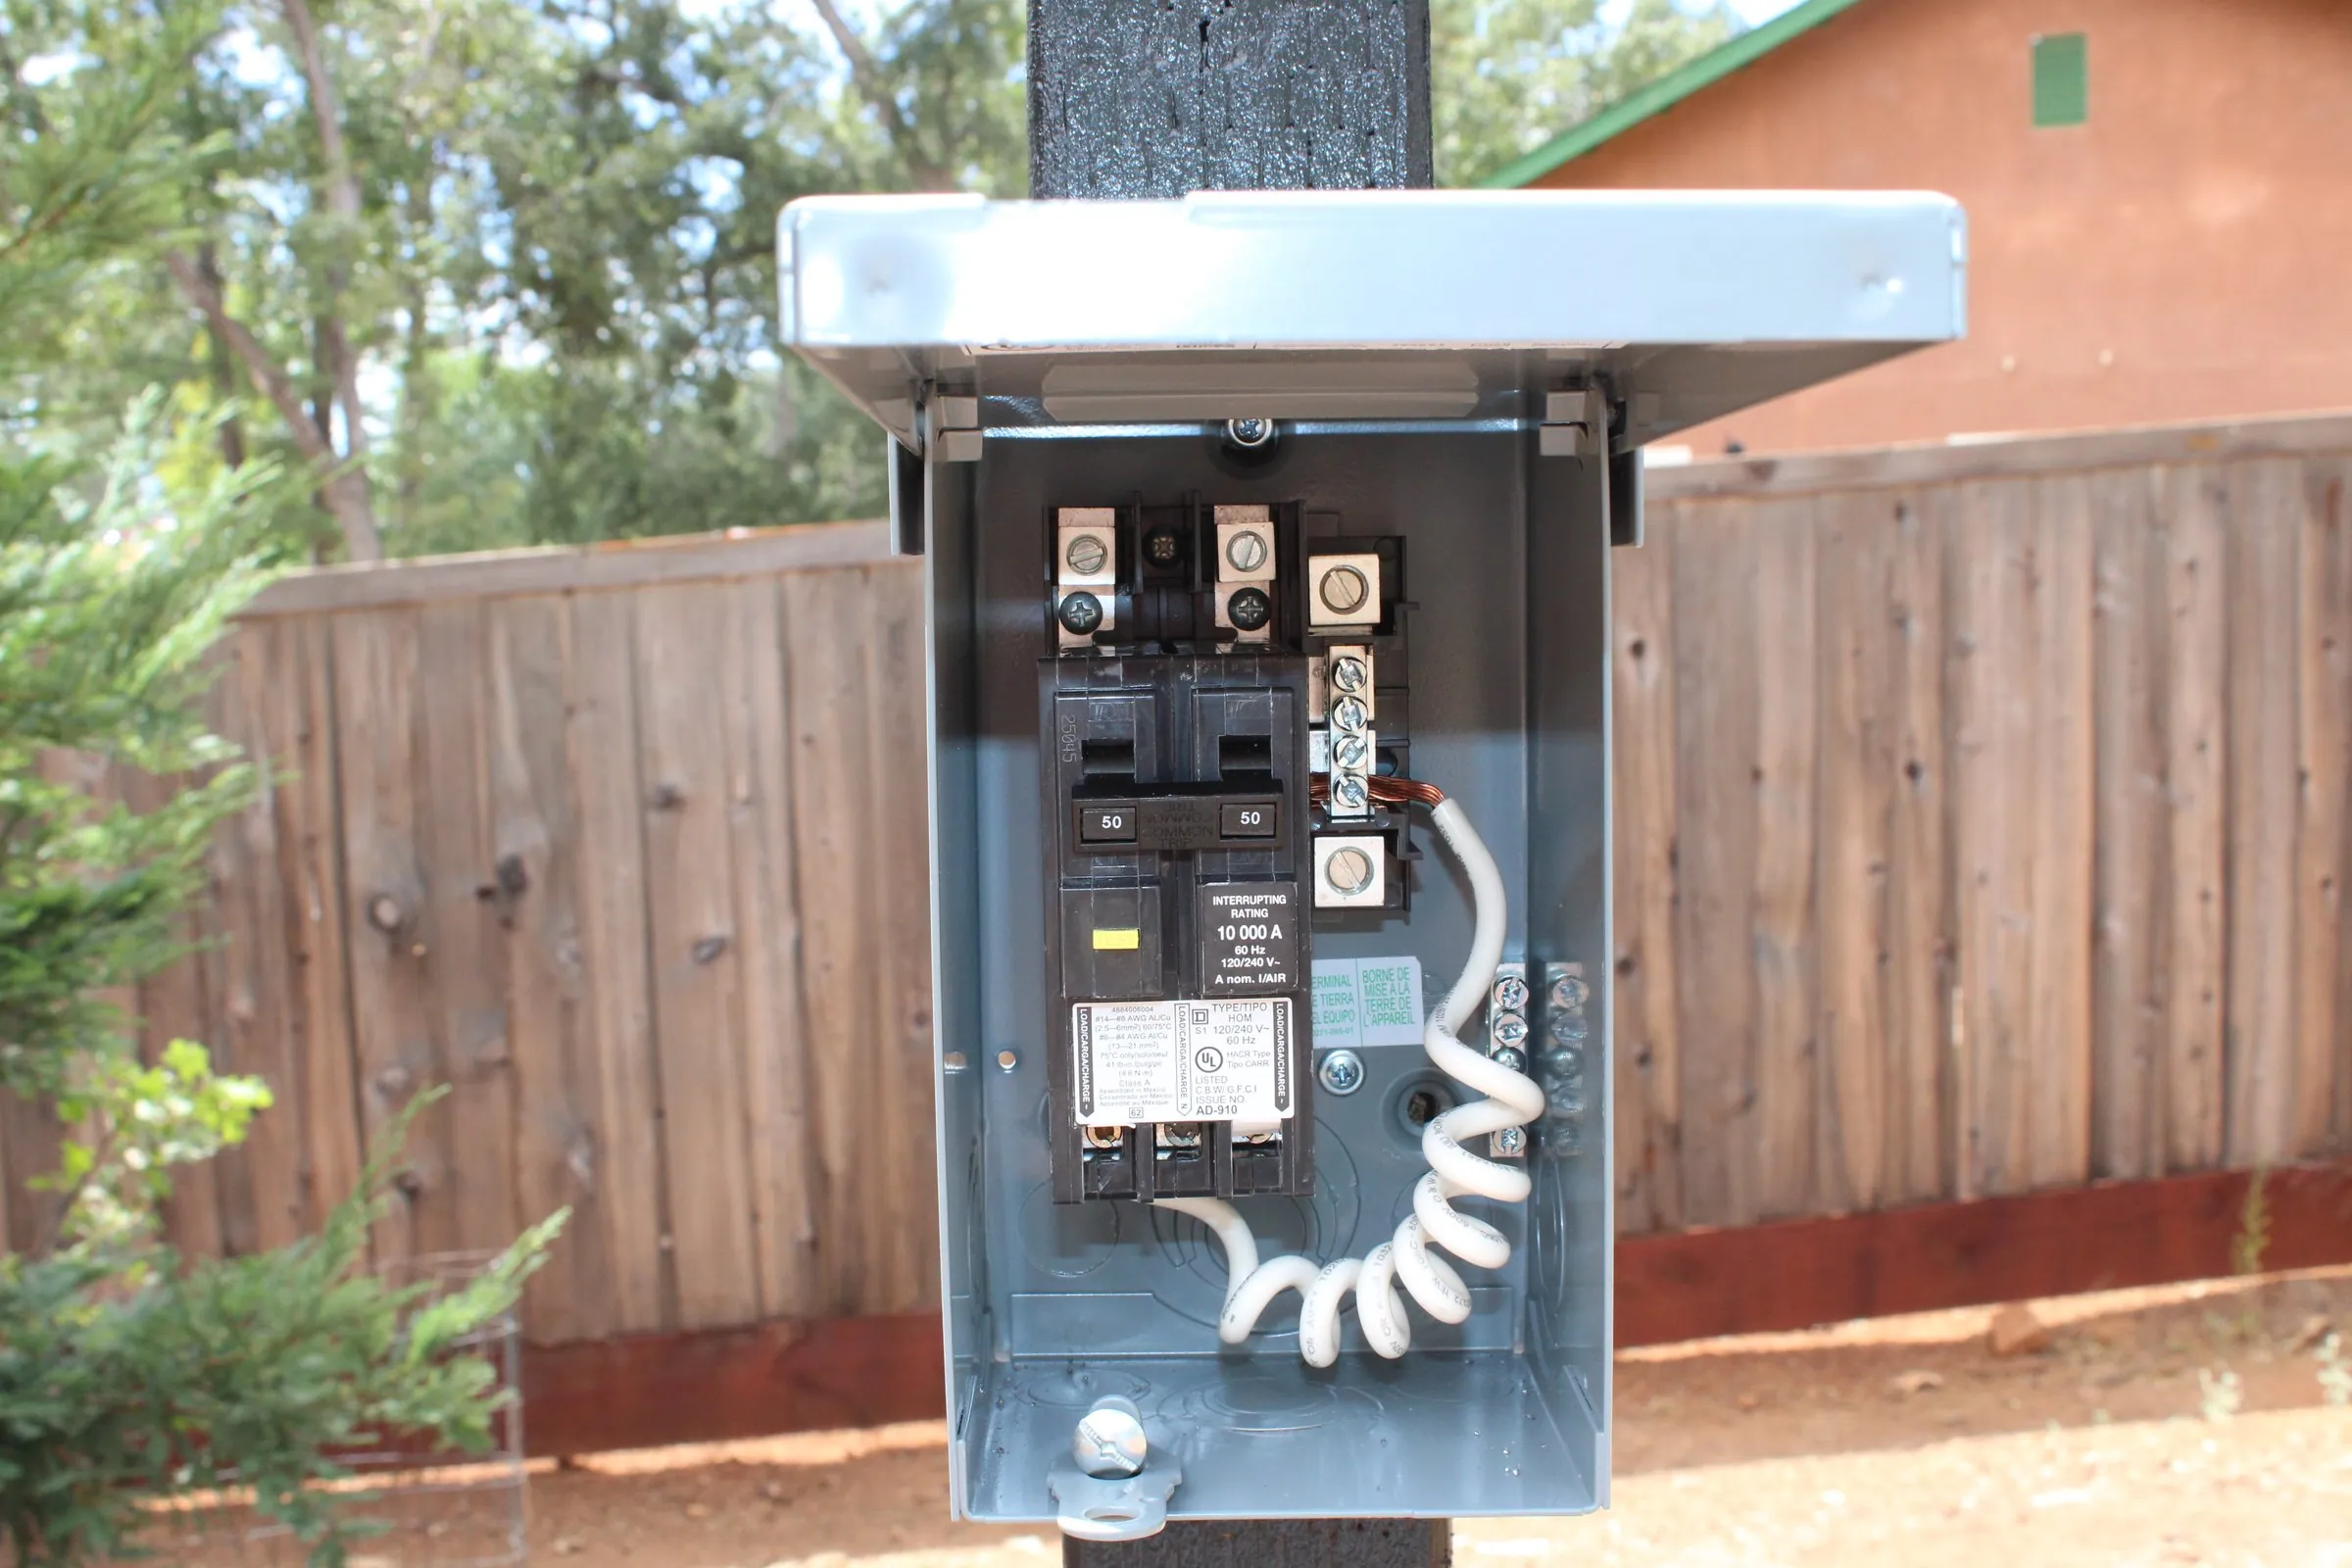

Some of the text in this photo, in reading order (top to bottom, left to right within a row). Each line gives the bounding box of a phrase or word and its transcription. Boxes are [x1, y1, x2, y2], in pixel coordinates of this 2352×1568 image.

[1060, 714, 1076, 762] 25045
[1102, 815, 1122, 829] 50
[1240, 811, 1260, 825] 50
[1212, 895, 1287, 906] INTERRUPTING
[1230, 908, 1269, 919] RATING
[1217, 924, 1283, 941] 10 000 A
[1235, 945, 1265, 955] 60 Hz
[1221, 957, 1264, 967] 120/240
[1215, 973, 1287, 984] A nom. I/AIR
[1312, 974, 1352, 989] ERMINAL
[1362, 966, 1410, 984] BORNE DE
[1364, 983, 1388, 998] MISE
[1397, 982, 1410, 996] LA
[1319, 992, 1354, 1006] TIERRA
[1364, 996, 1411, 1013] TERRE DE
[1211, 1003, 1267, 1012] TYPE/TIPO
[1228, 1013, 1252, 1022] HOM
[1323, 1009, 1355, 1024] EQUIPO
[1213, 1025, 1252, 1035] 120/240
[1226, 1036, 1255, 1045] 60 Hz
[1080, 1008, 1090, 1102] LOAD/CARGA/CHARGE
[1178, 1005, 1187, 1098] LOAD/CARGA/CHARGE
[1276, 1004, 1285, 1097] LOAD/CARGA/CHARGE
[1196, 1096, 1226, 1104] ISSUE
[1196, 1105, 1238, 1115] AD-910
